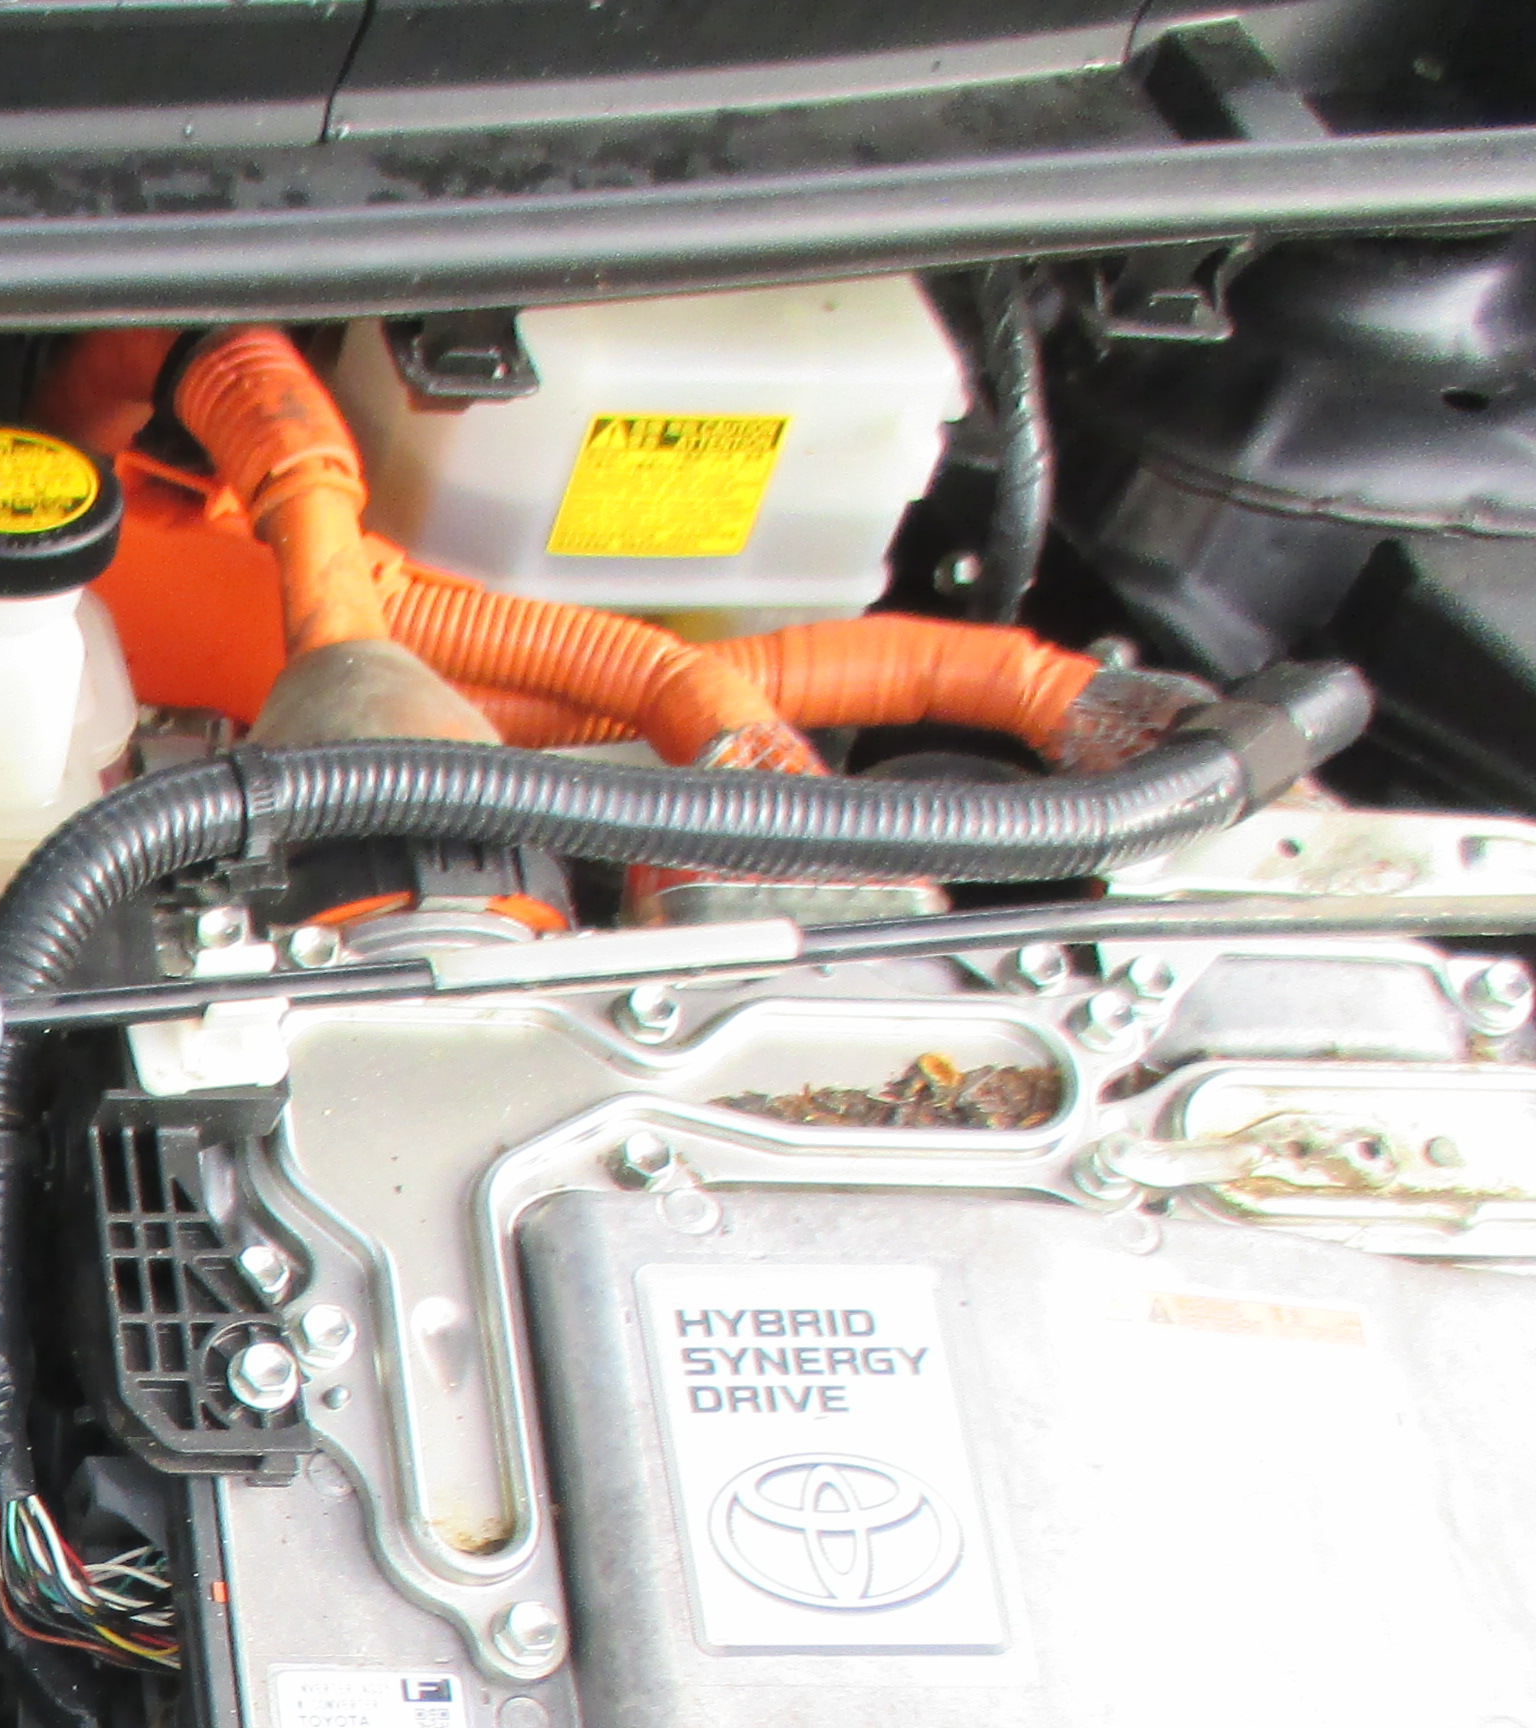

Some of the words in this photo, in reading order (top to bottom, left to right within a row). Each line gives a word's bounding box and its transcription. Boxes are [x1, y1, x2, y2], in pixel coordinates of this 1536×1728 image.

[673, 1308, 877, 1338] HYBRID
[681, 1346, 930, 1376] SYNERGY
[686, 1384, 851, 1414] DRIVE
[297, 1714, 370, 1728] TOYOTA
